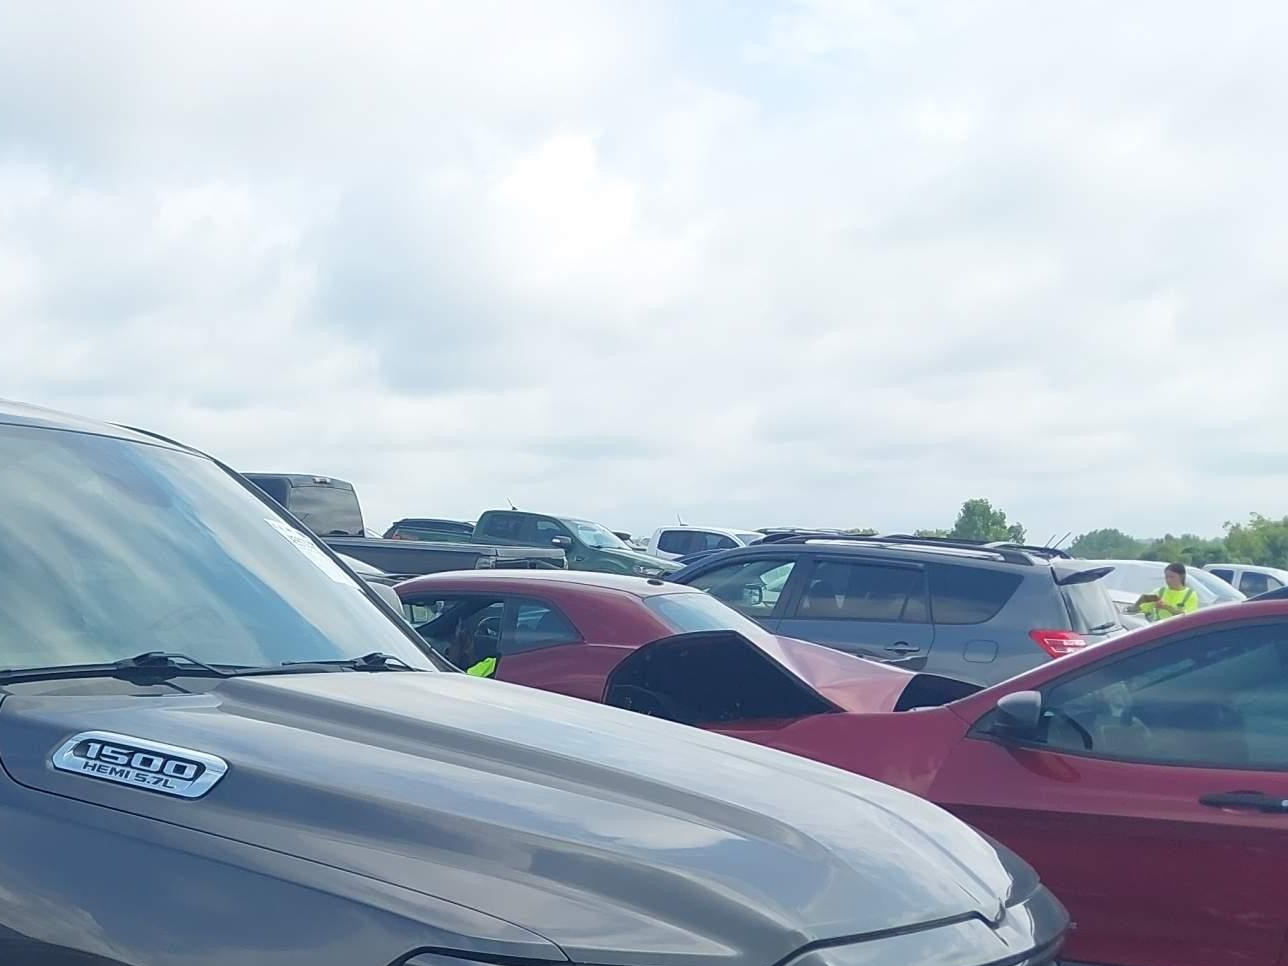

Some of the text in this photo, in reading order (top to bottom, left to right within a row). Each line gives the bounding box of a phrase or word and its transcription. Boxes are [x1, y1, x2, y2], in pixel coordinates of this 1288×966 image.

[82, 761, 177, 789] HEMI 5.7L
[85, 742, 197, 779] 1500
